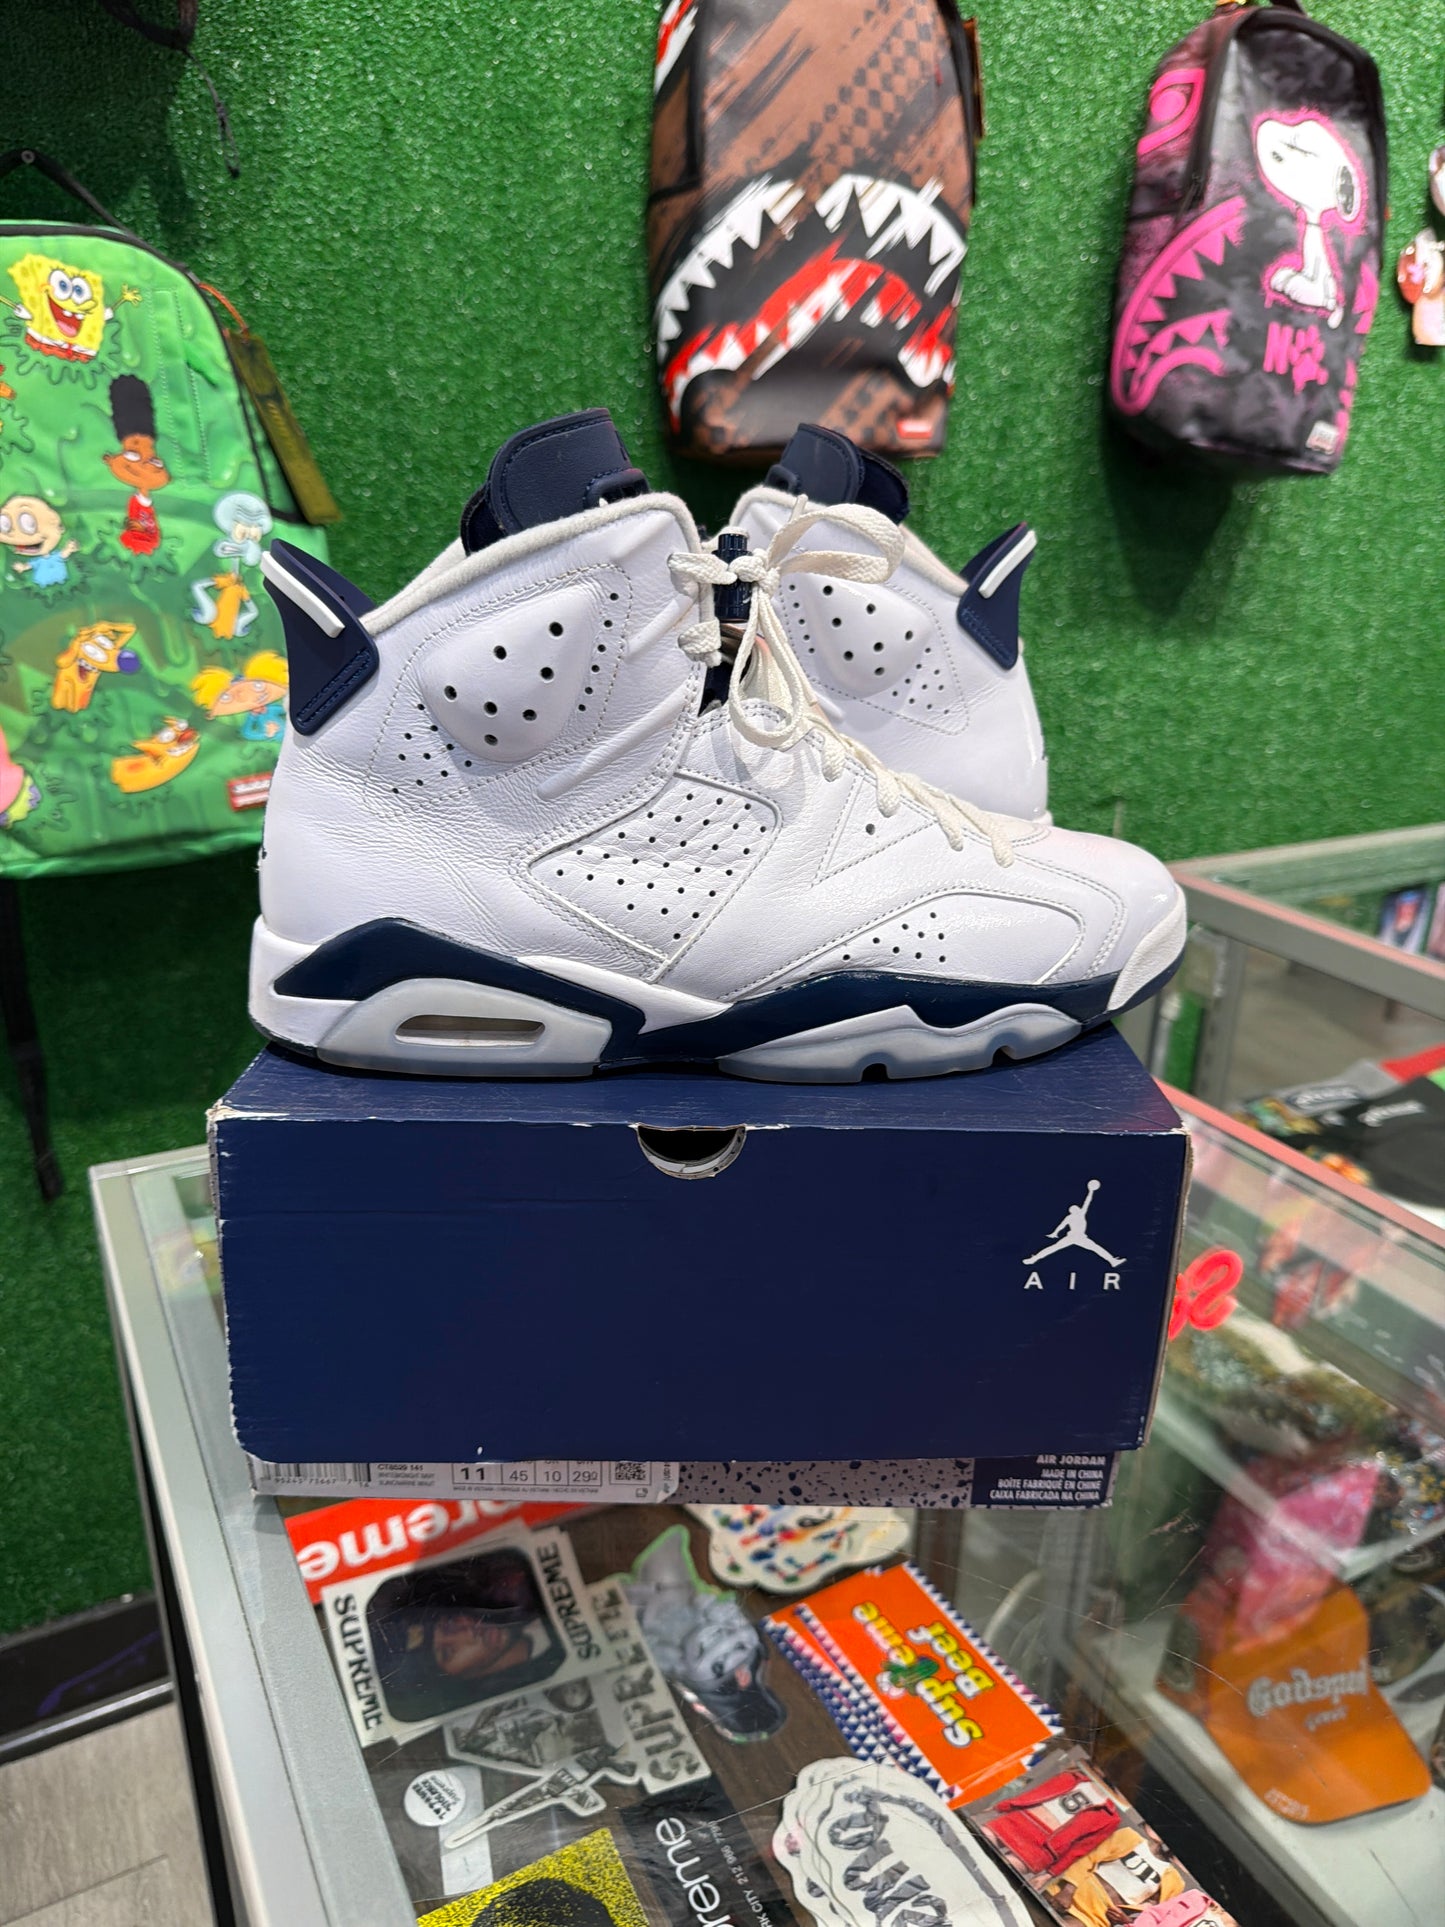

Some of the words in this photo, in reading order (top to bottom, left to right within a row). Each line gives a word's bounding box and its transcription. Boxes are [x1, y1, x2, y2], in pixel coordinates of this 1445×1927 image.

[1023, 1272, 1121, 1291] AIR
[1036, 1454, 1057, 1465] AIR
[1059, 1455, 1106, 1466] JORDAN
[460, 1467, 486, 1481] 11
[509, 1470, 529, 1482] 45
[544, 1470, 562, 1482] 10
[1041, 1469, 1065, 1478] MADE
[1066, 1469, 1077, 1478] IN
[1078, 1469, 1104, 1479] CHINA
[1064, 1480, 1075, 1489] EN
[1077, 1480, 1101, 1490] CHINE
[990, 1490, 1014, 1499] CAIXA
[1015, 1490, 1060, 1500] FABRICADA
[1061, 1491, 1073, 1500] NA
[1075, 1491, 1100, 1500] CHINA
[536, 1541, 601, 1660] SUPREME
[334, 1592, 384, 1732] SUPREME
[907, 1620, 995, 1699] Beef
[656, 1817, 735, 1927] reme
[730, 1865, 749, 1885] 212
[1119, 1851, 1162, 1884] UP
[743, 1889, 763, 1914] CITY
